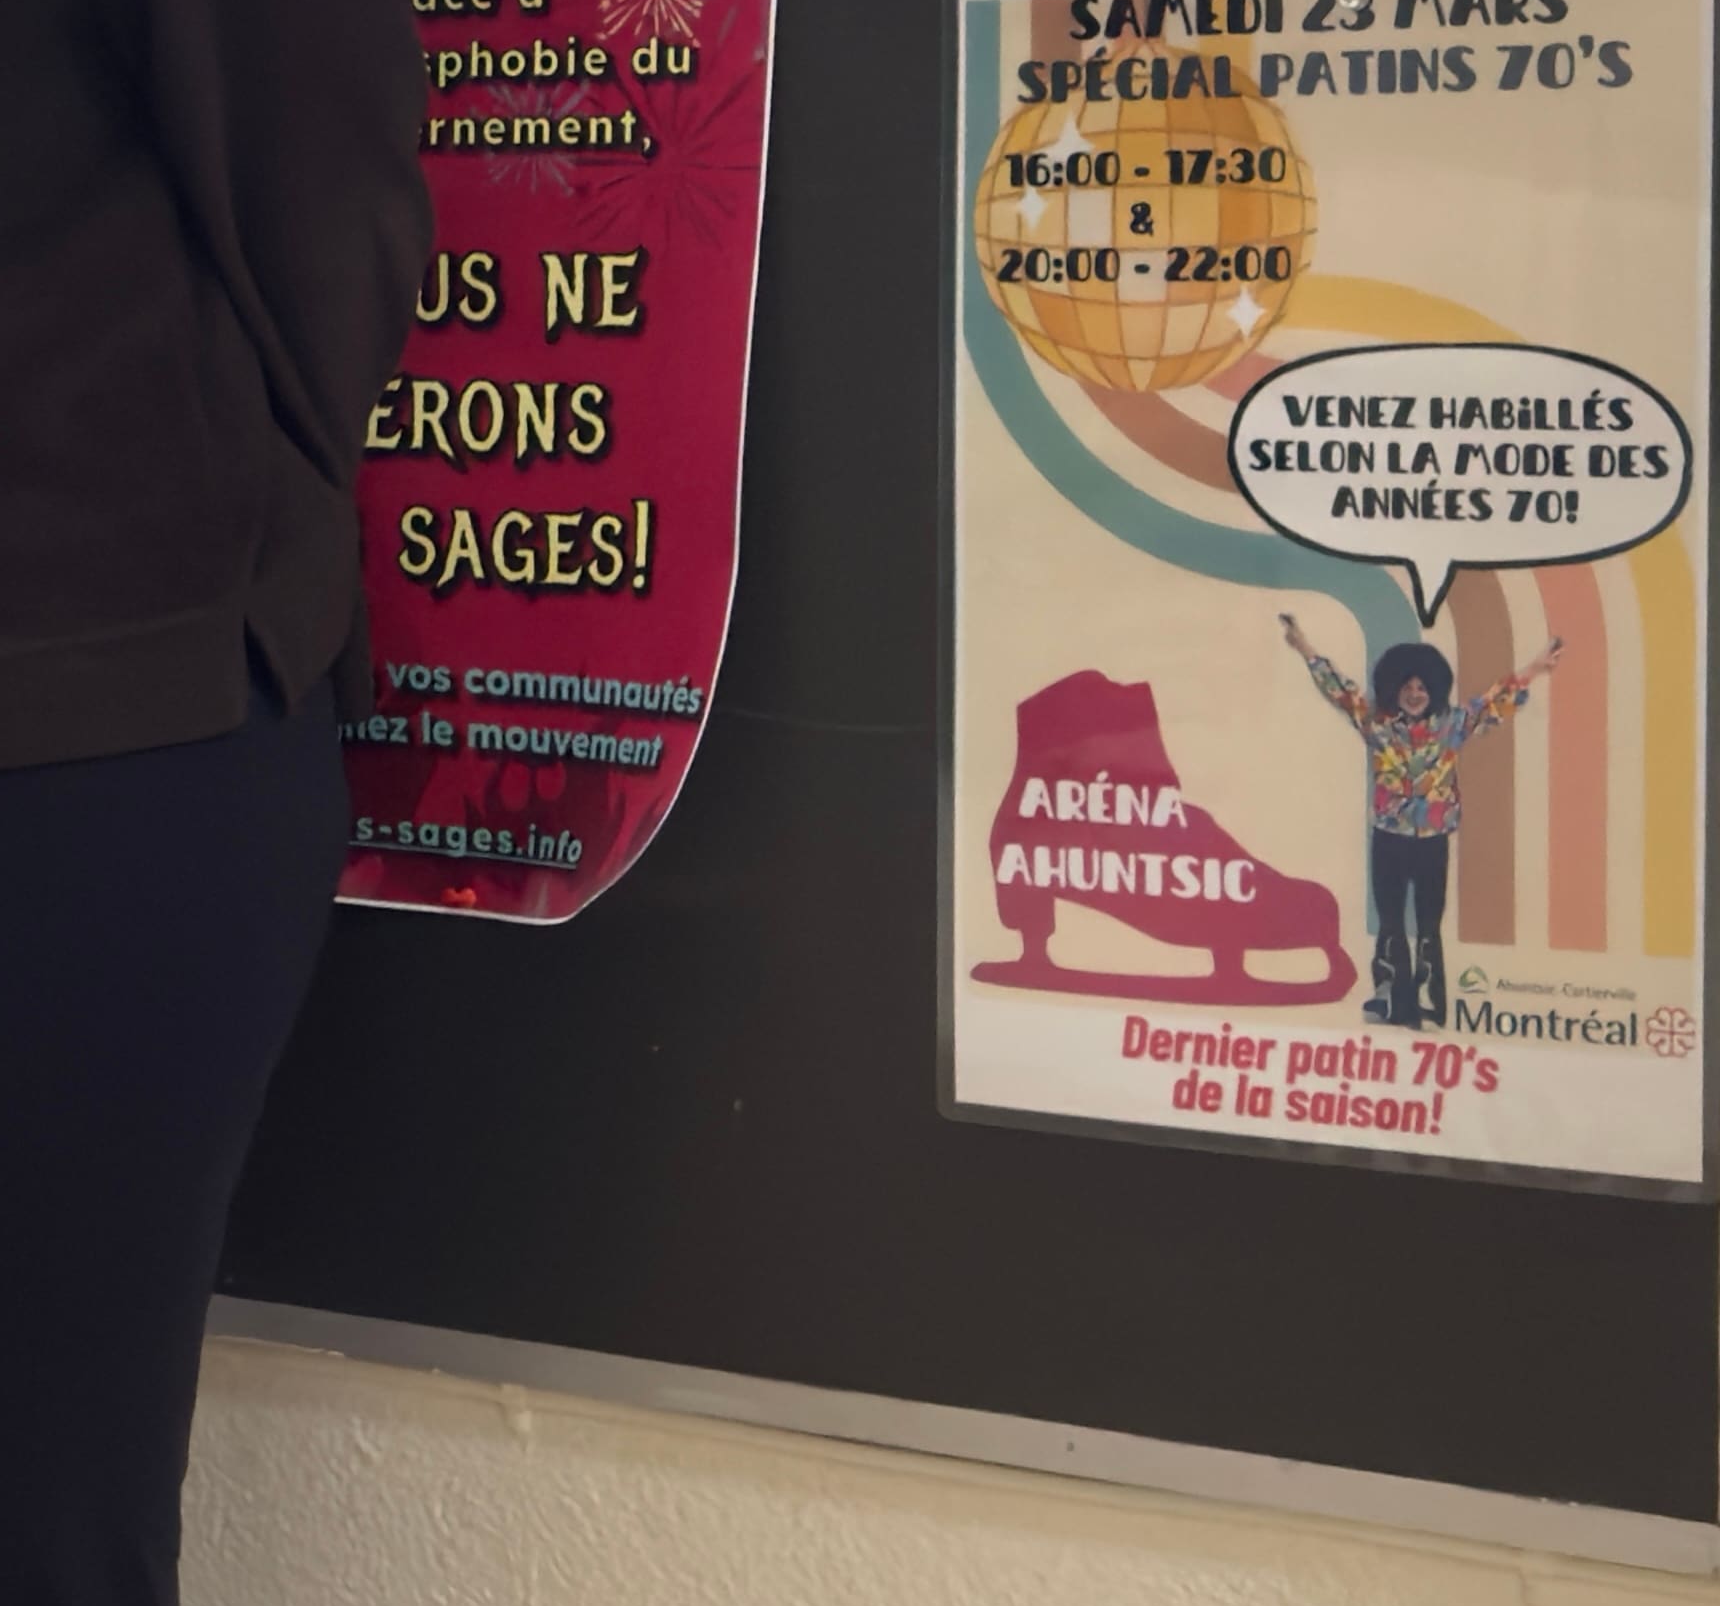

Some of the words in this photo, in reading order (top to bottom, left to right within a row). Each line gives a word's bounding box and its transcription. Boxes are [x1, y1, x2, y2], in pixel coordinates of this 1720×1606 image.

[423, 36, 608, 88] phobie
[632, 37, 691, 75] du
[1016, 47, 1244, 103] SPÉCIAL
[1259, 44, 1477, 97] PATINS
[1496, 35, 1634, 91] 70'S
[420, 110, 652, 150] rnement,
[1005, 151, 1122, 188] 16:00
[1165, 147, 1287, 185] 17:30
[1129, 201, 1156, 236] &
[414, 252, 497, 323] US
[542, 249, 643, 331] NE
[997, 247, 1122, 284] 20:00
[1164, 246, 1293, 284] 22:00
[365, 379, 606, 460] ERONS
[1283, 395, 1418, 429] VENEZ
[1249, 440, 1376, 474] SELON
[1387, 442, 1441, 475] LA
[1454, 443, 1576, 477] MODE
[1588, 444, 1670, 479] DES
[1331, 479, 1494, 521] ANNÉES
[1506, 490, 1580, 524] 70!
[398, 499, 651, 590] SAGES!
[387, 662, 451, 693] vos
[464, 668, 704, 714] communautés
[420, 711, 454, 745] le
[467, 723, 663, 767] mouvement
[1018, 771, 1188, 828] ARÉNA
[356, 817, 583, 865] s-sages.info
[996, 844, 1257, 903] AHUNTSIC
[1454, 998, 1638, 1045] Montréal
[1121, 1015, 1276, 1073] Dernier
[1285, 1031, 1398, 1083] patin
[1411, 1042, 1500, 1093] 70's
[1172, 1070, 1226, 1111] de
[1233, 1075, 1275, 1119] la
[1285, 1085, 1444, 1134] saison!
